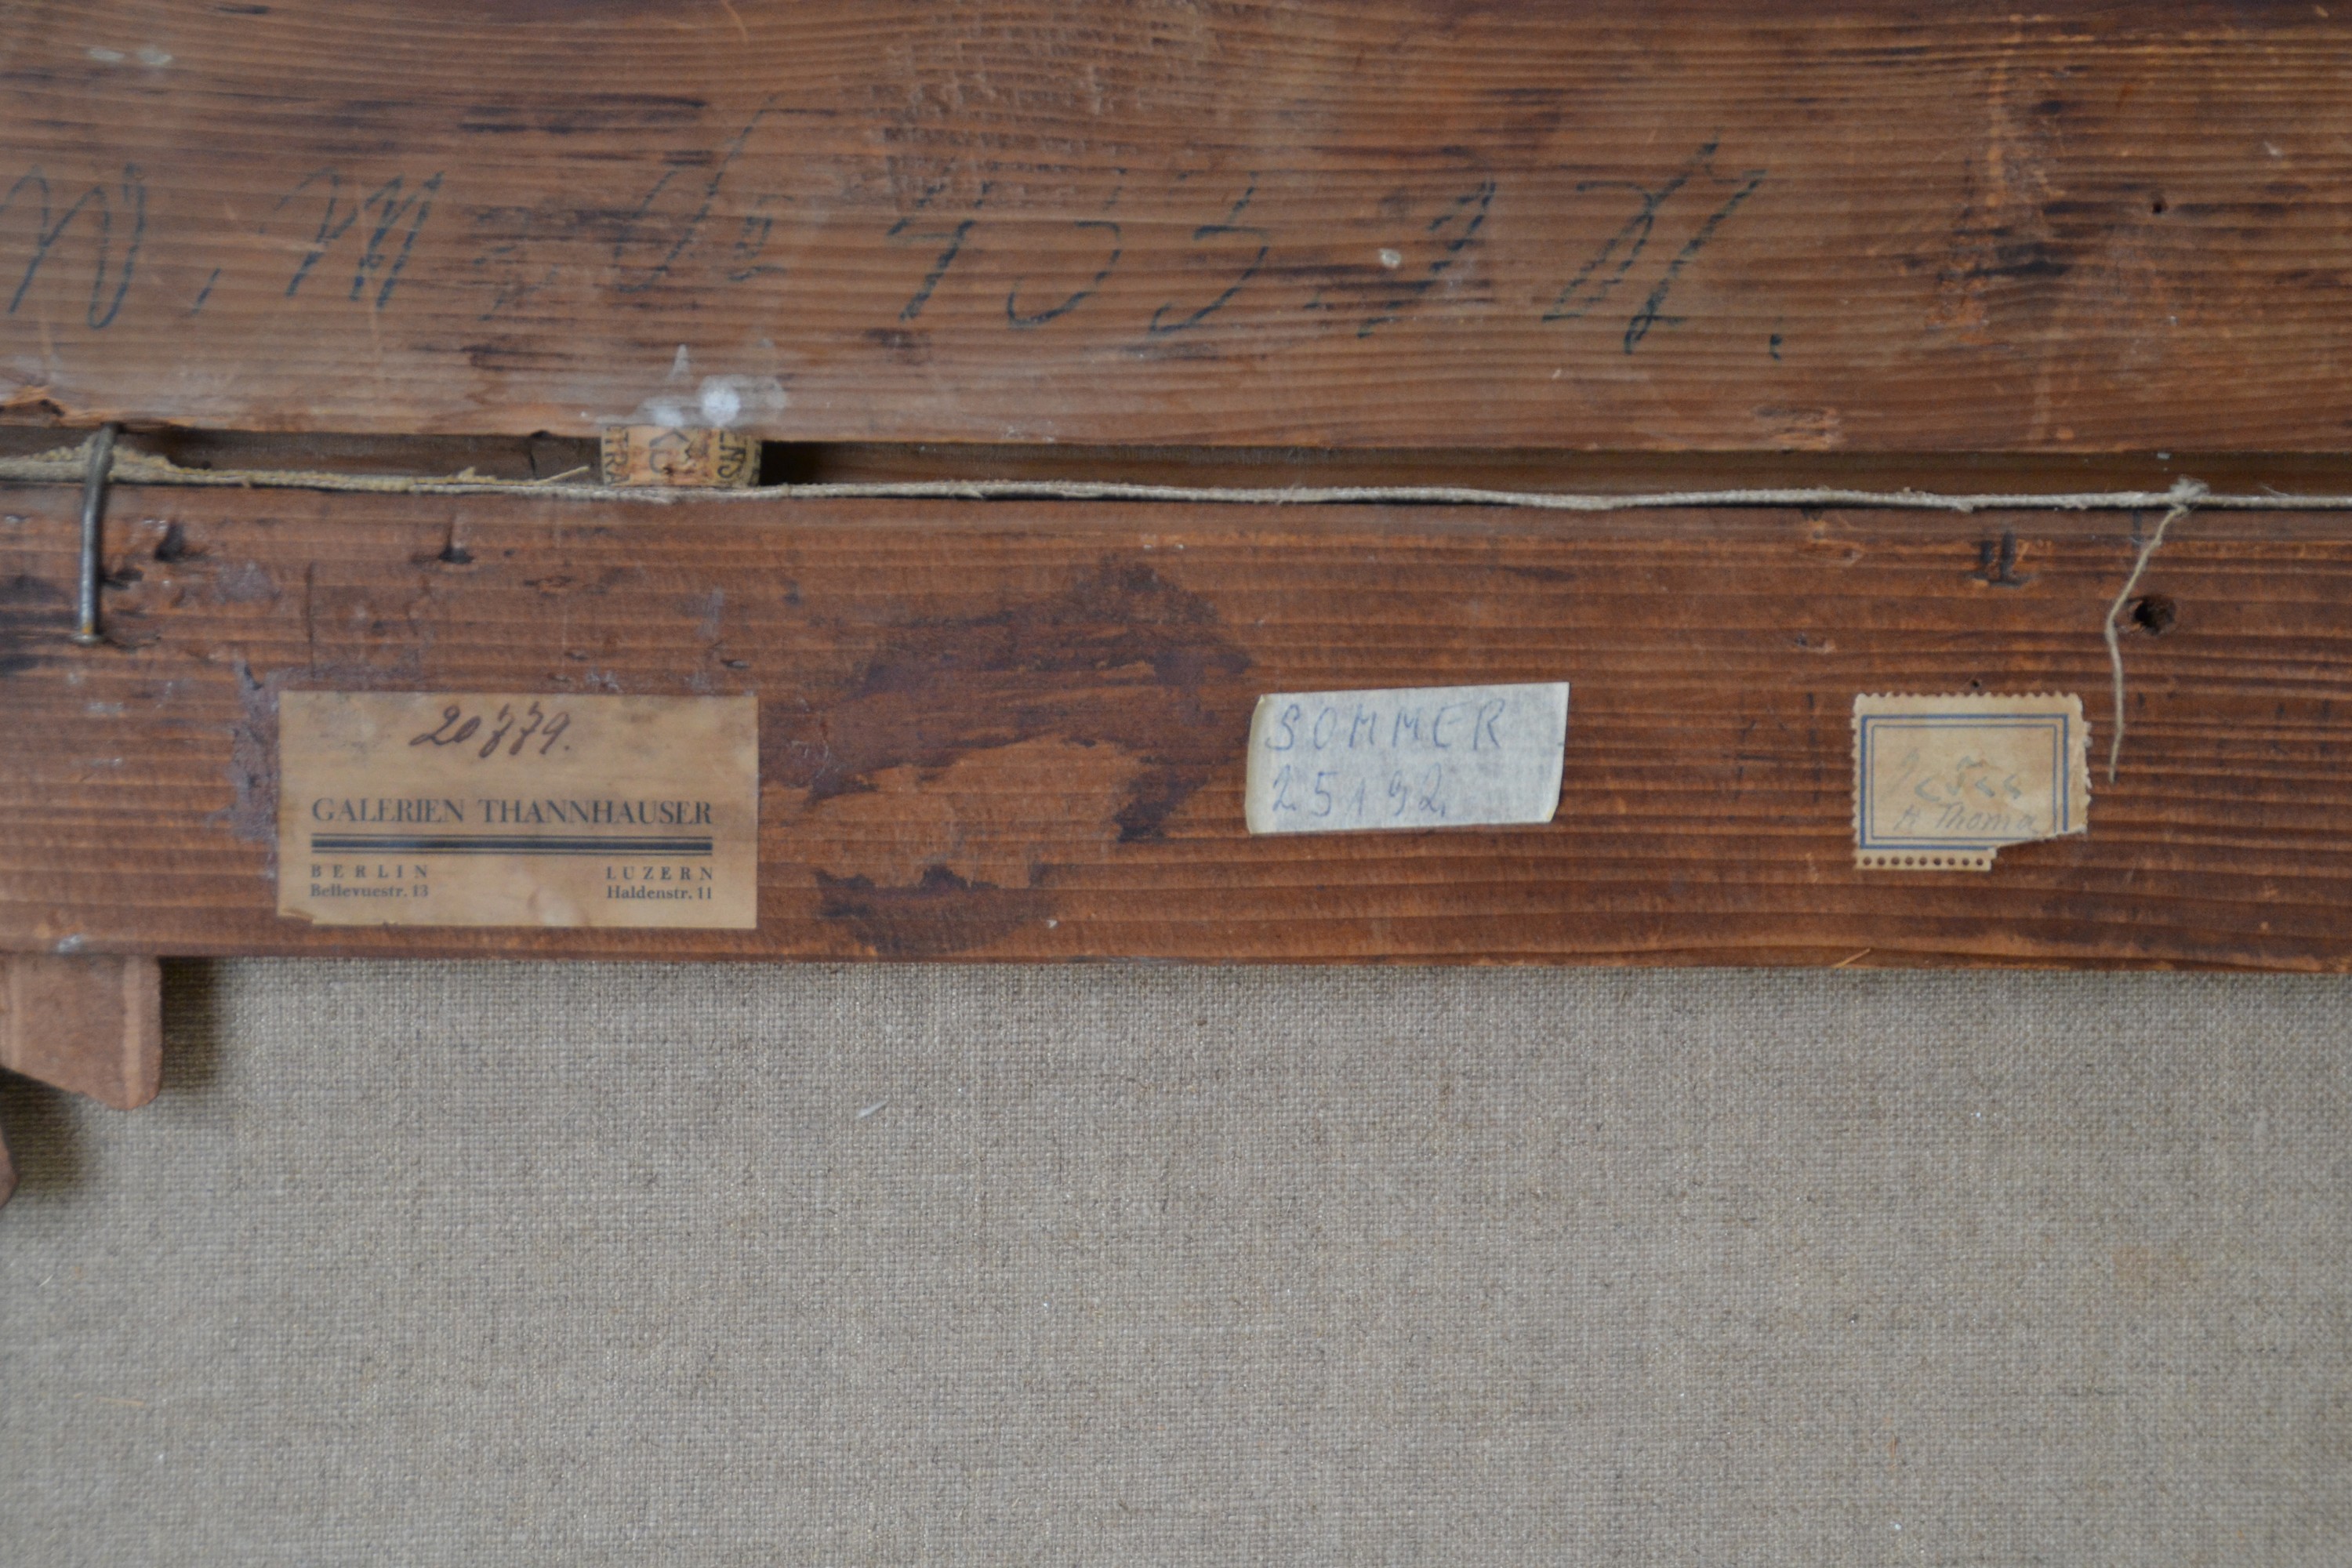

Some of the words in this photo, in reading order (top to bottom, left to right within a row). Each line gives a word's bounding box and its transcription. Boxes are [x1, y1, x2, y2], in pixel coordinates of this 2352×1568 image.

[1265, 698, 1506, 752] SOMMER
[311, 797, 465, 824] GALERIEN
[477, 799, 713, 826] THANNHAUSER
[310, 864, 428, 880] BERLIN
[606, 866, 713, 880] LUZERN
[309, 883, 408, 898] Bellevuestr.
[412, 884, 429, 898] 13
[606, 885, 693, 901] Haldenstr.
[697, 886, 713, 900] 11
